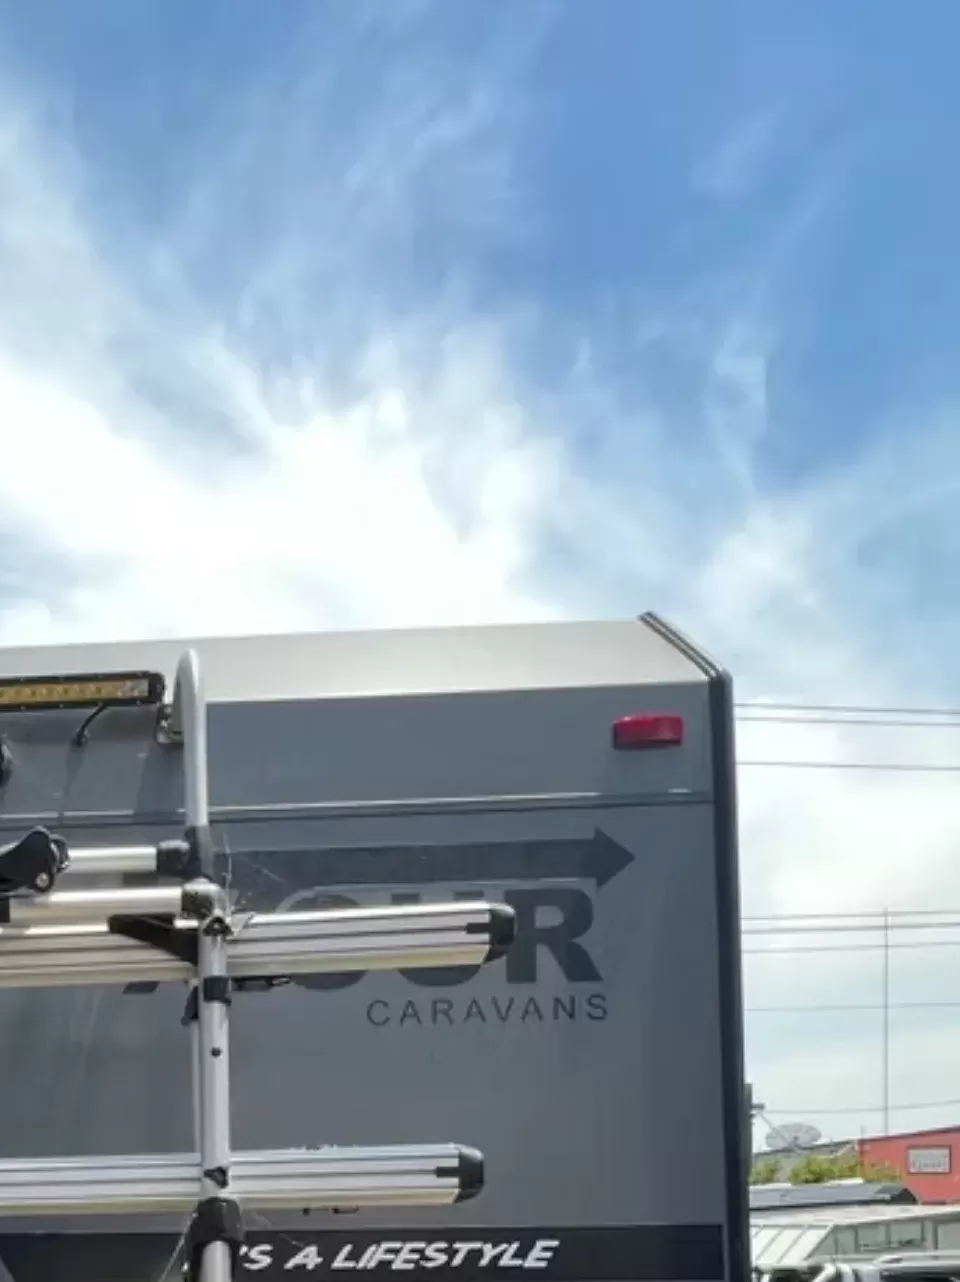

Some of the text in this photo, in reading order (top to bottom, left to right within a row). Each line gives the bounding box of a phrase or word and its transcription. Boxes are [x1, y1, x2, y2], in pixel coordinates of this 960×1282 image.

[365, 993, 609, 1027] CARAVANS
[283, 1244, 324, 1270] A
[330, 1239, 561, 1270] LIFESTYLE
